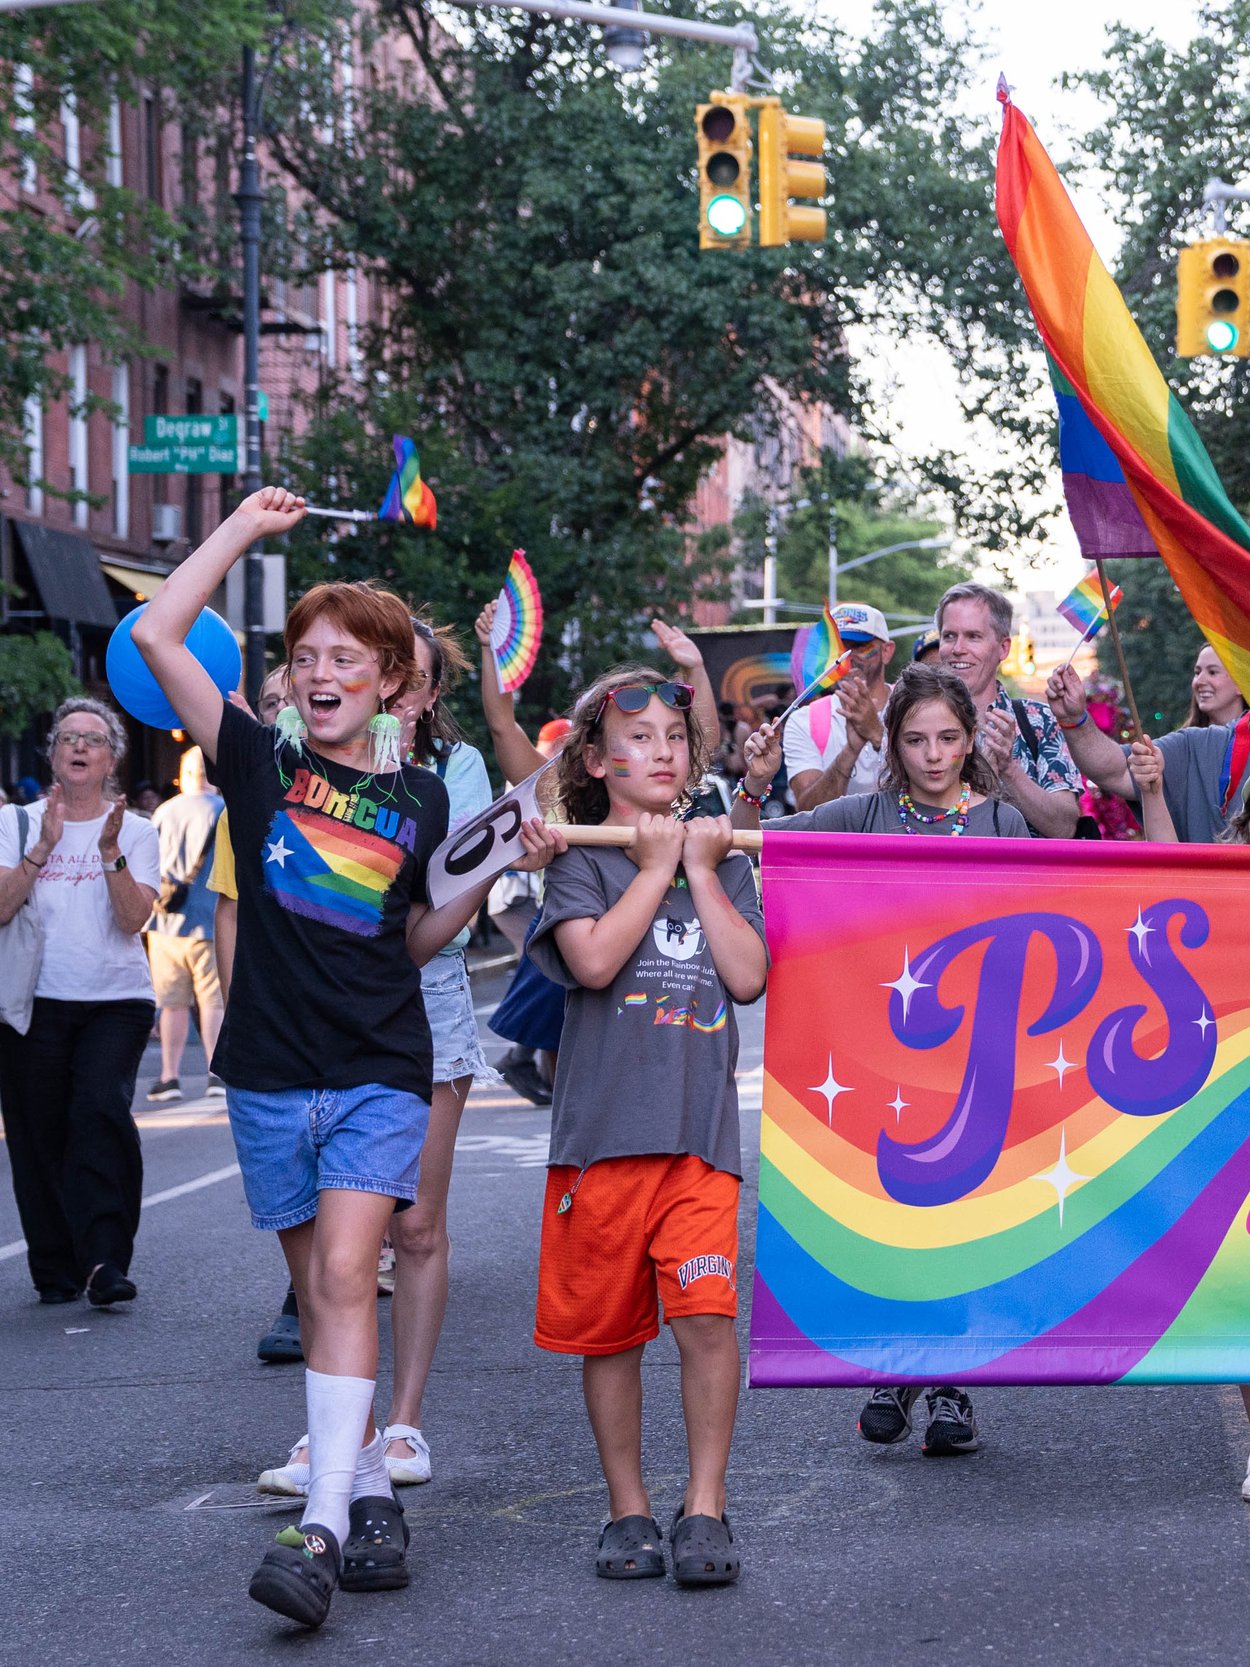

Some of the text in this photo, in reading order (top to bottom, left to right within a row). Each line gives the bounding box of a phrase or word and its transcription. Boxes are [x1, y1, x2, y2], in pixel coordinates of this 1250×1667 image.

[156, 416, 212, 443] Degraw
[130, 445, 170, 461] Robert
[208, 445, 234, 462] Diaz
[283, 768, 417, 854] BORICUA
[67, 854, 88, 864] ALL
[637, 959, 655, 967] Join
[656, 958, 670, 967] the
[635, 970, 662, 979] Where
[663, 970, 674, 979] all
[662, 981, 681, 990] Even
[876, 898, 1219, 1208] PS
[677, 1254, 736, 1291] VIRGIN
